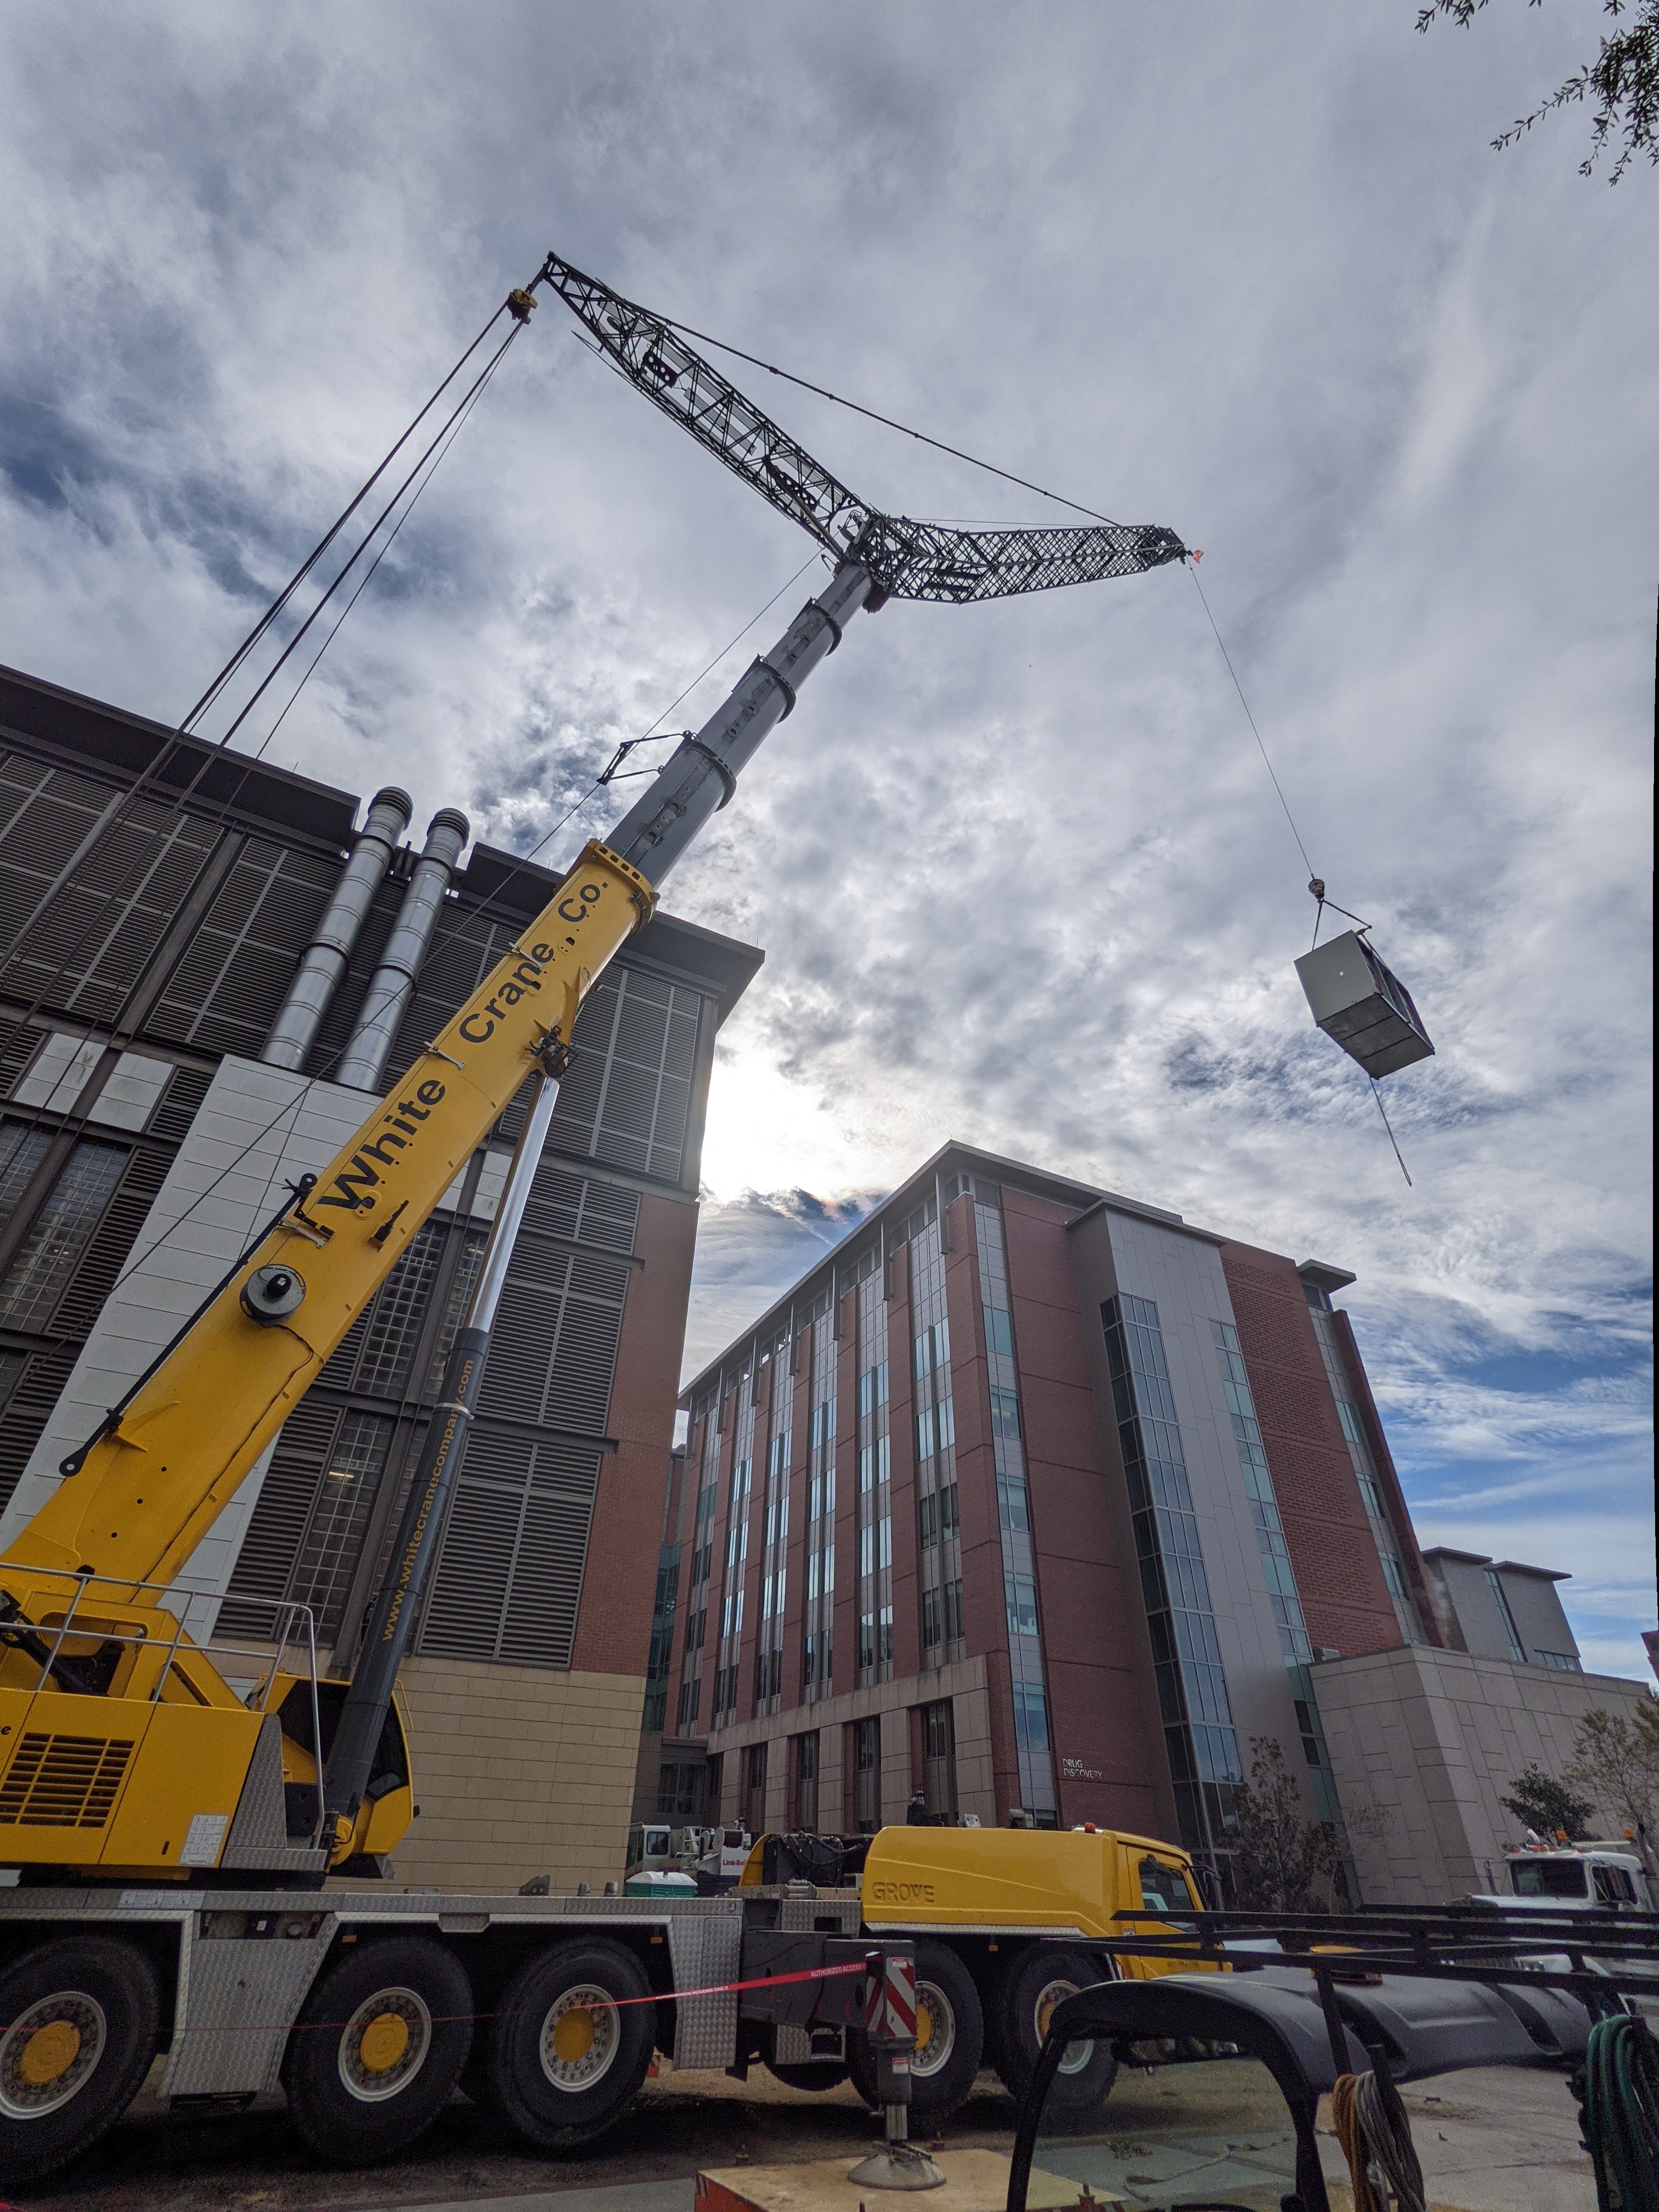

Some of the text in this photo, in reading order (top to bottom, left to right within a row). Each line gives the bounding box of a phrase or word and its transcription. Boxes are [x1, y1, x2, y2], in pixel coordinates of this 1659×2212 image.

[317, 882, 608, 1209] White Crane Co.
[383, 1359, 474, 1641] www.whitecranecompany.com
[1063, 1758, 1083, 1768] DRUG
[1063, 1768, 1102, 1779] DISCOVERY
[872, 1881, 934, 1904] GROVE
[811, 1966, 843, 1978] AUTHORIZED
[843, 1963, 862, 1973] ACCESS
